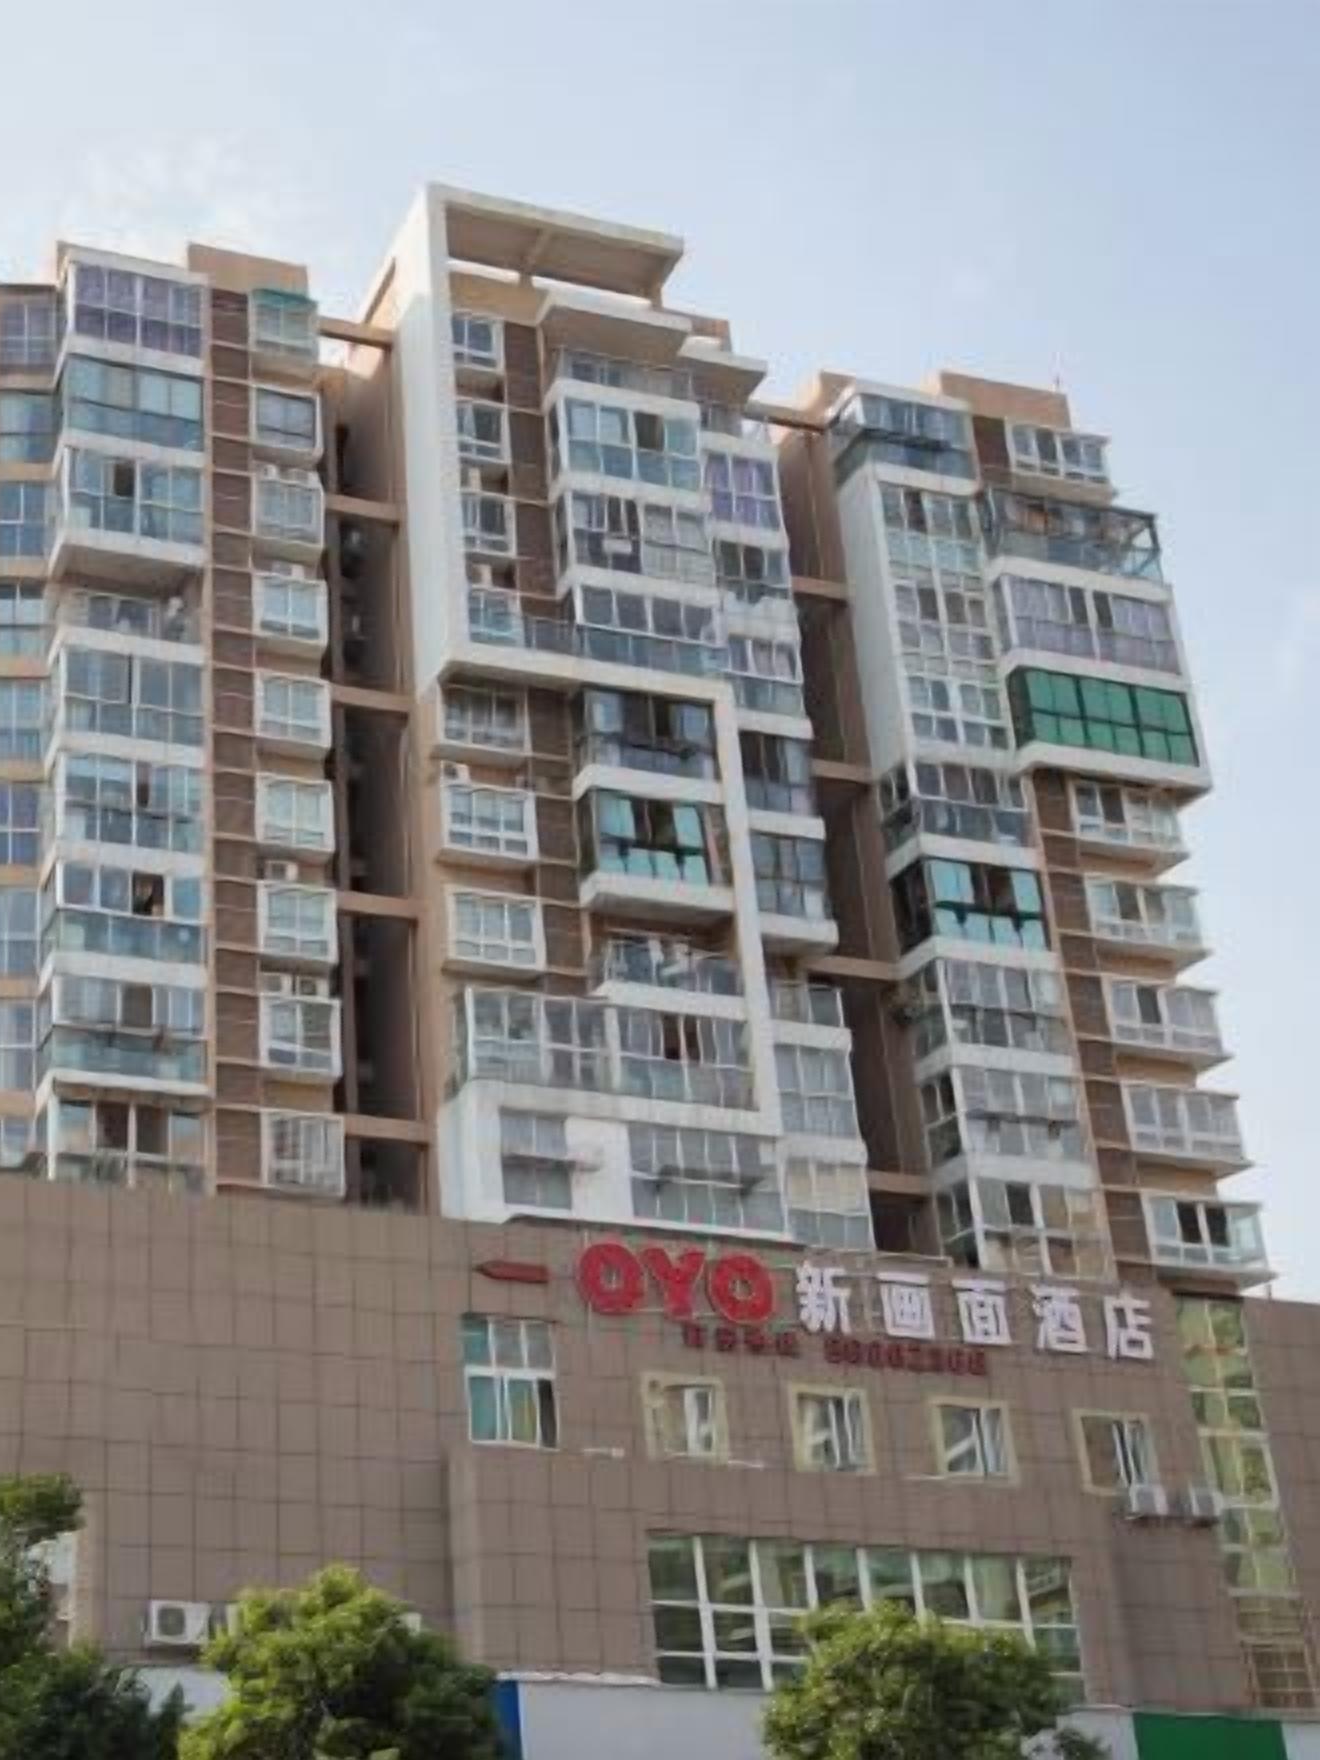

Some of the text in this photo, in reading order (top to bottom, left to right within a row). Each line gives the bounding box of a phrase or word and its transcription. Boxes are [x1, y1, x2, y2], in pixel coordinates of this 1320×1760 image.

[577, 1243, 774, 1324] OYO
[795, 1260, 1154, 1360] 新画面酒店
